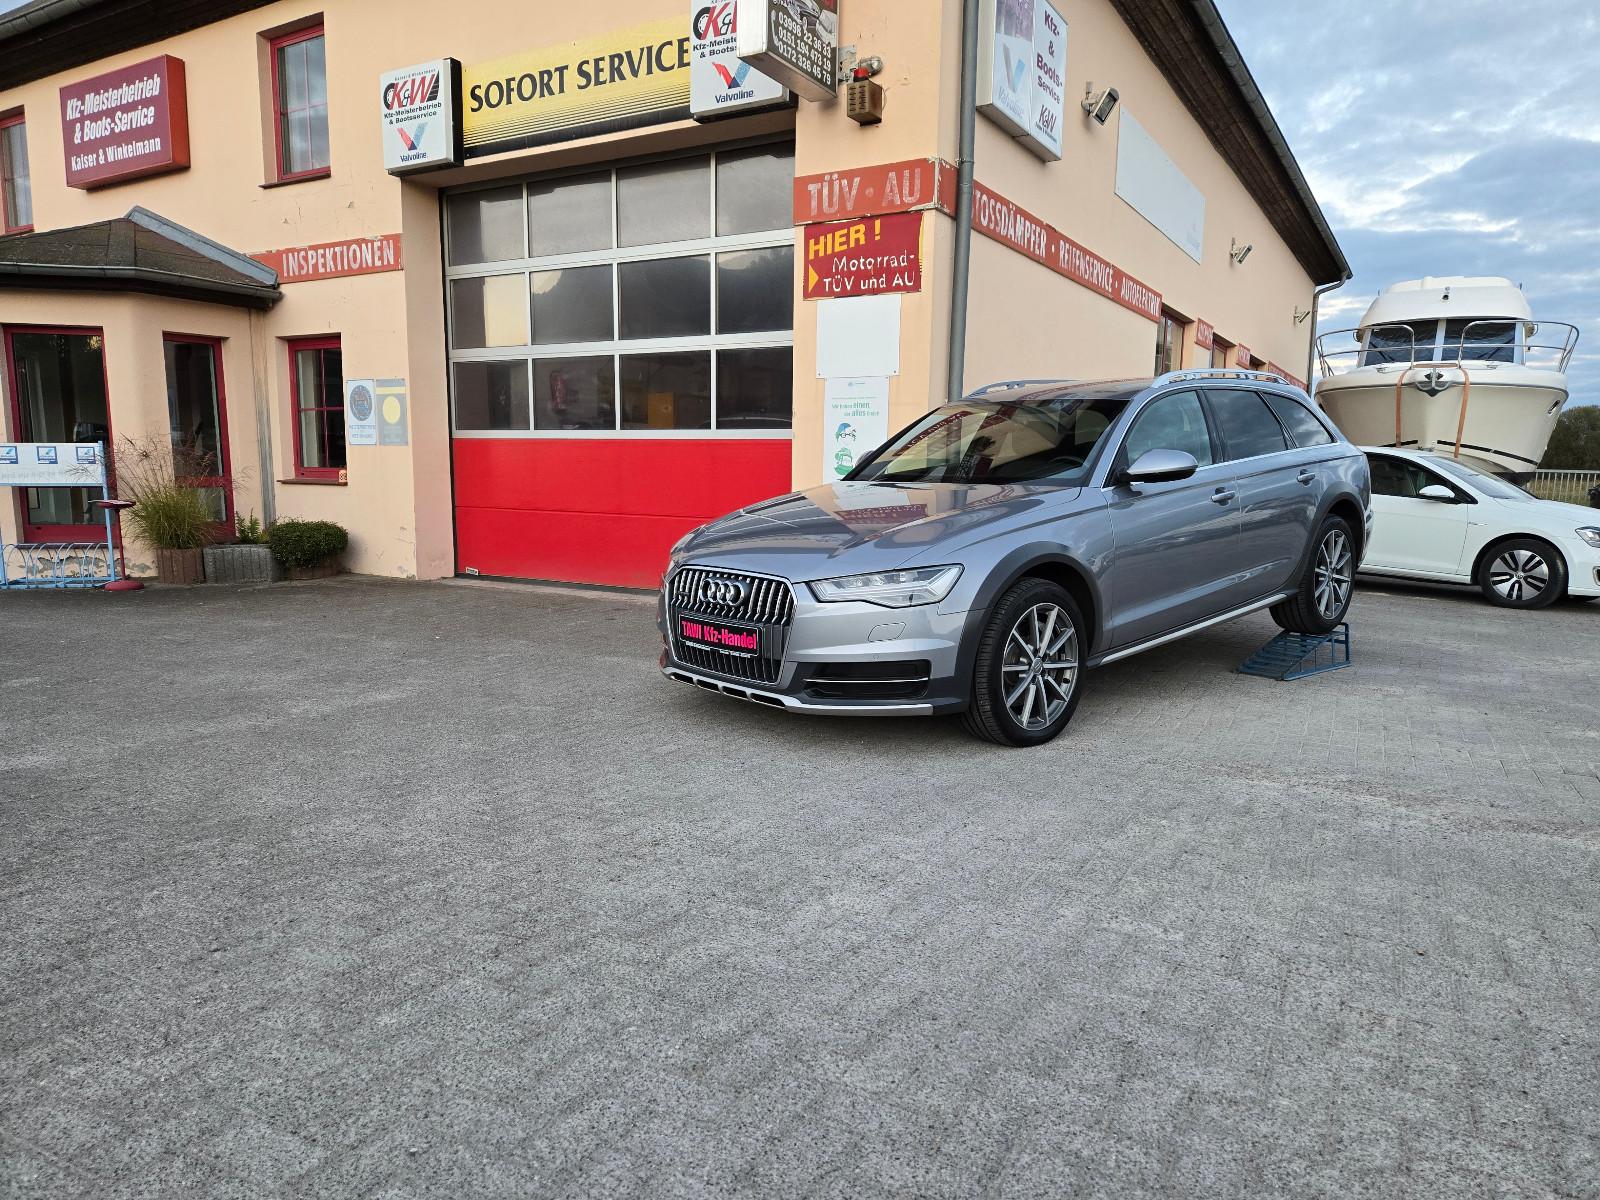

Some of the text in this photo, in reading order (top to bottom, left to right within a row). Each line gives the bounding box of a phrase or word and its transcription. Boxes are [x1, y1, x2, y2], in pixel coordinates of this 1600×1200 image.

[1044, 10, 1060, 36] Kfz-
[693, 36, 737, 52] Kfz-Meiste
[779, 26, 831, 72] 0151 194 473 19
[804, 29, 812, 46] 22
[814, 37, 822, 52] 36
[822, 42, 831, 58] 33
[1048, 40, 1054, 58] &
[470, 37, 690, 112] SOFORT SERVICE
[779, 40, 830, 85] 0172 326 45 79
[1036, 52, 1062, 87] Boots-
[66, 74, 160, 120] Kfz-Meisterbetrieb
[714, 89, 754, 104] Valvoline
[1038, 75, 1060, 104] Service
[74, 106, 154, 144] & Boots-Service
[384, 102, 442, 119] Kfz-Meisterbetrieb
[396, 110, 436, 124] Bootsservice
[72, 137, 160, 171] Kaiser & Winkelmann
[400, 152, 427, 162] Valvoline
[808, 168, 920, 216] TÜV AU
[808, 224, 866, 260] HIER
[971, 190, 1046, 258] TOSSDÄMPFER
[1059, 240, 1114, 292] REIFENSERVICE
[282, 240, 394, 277] INSPEKTIONEN
[832, 250, 914, 272] Motorrad-
[824, 272, 914, 292] TÜV und AU
[682, 620, 702, 640] TAWI
[704, 626, 756, 650] Kfz-Handel
